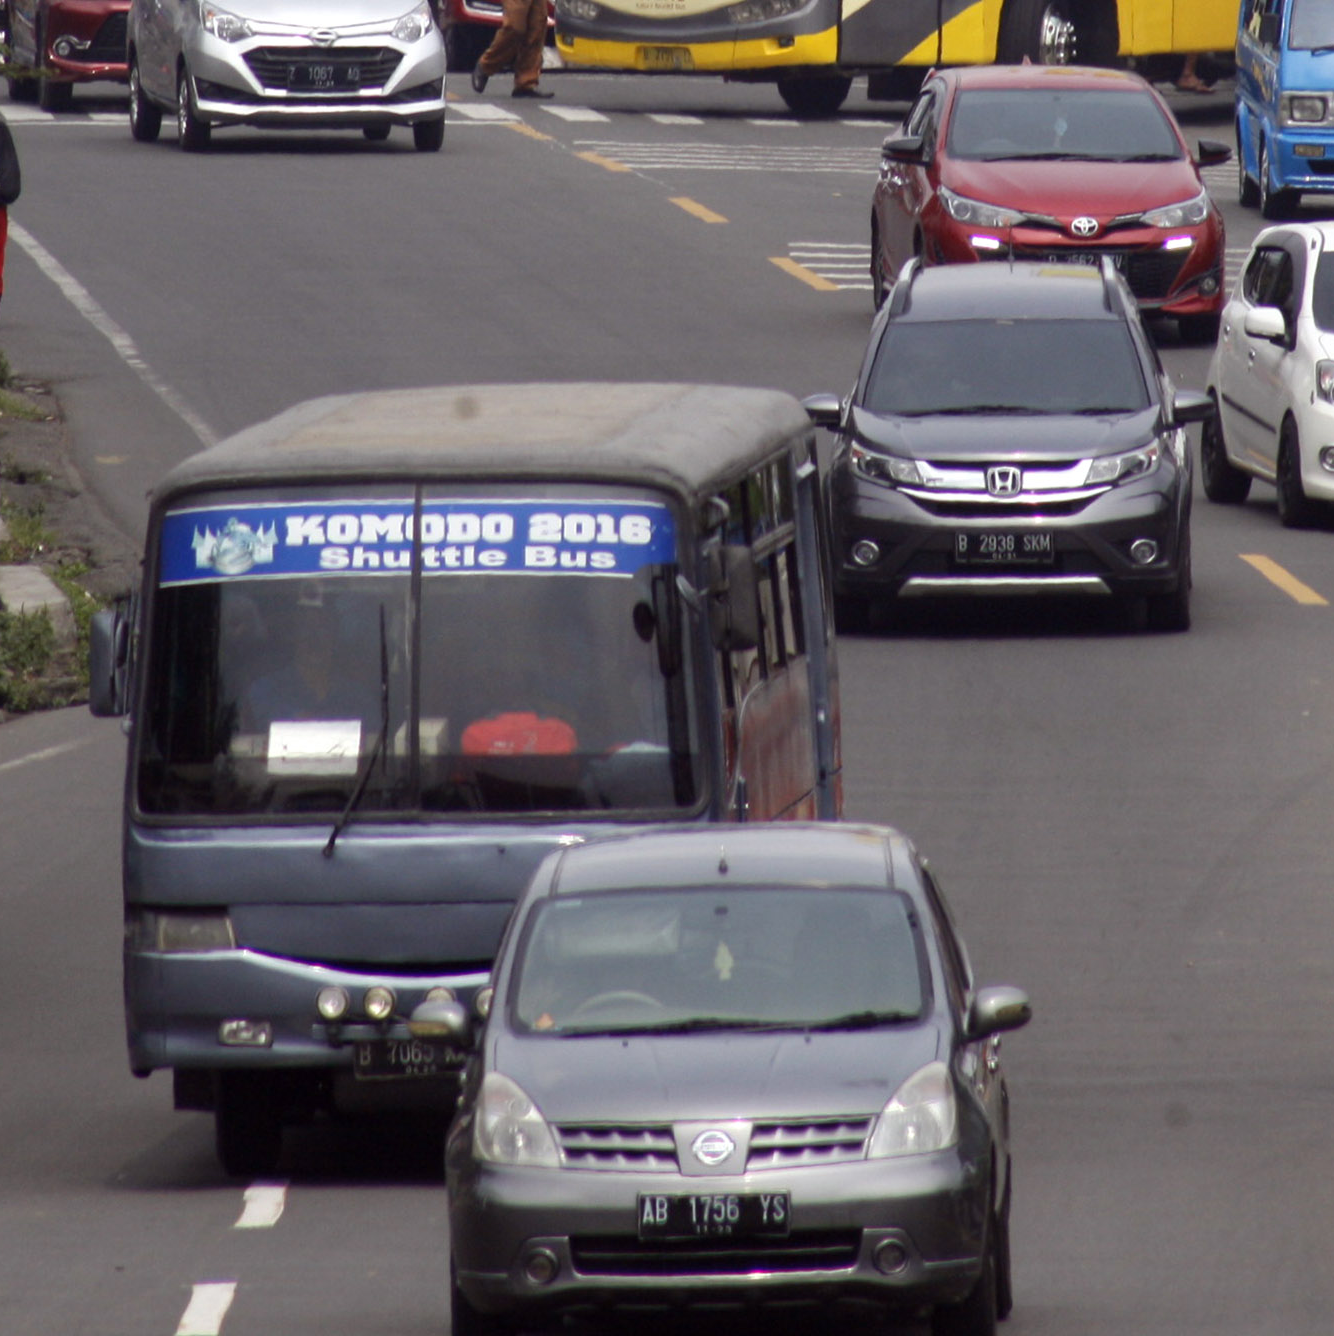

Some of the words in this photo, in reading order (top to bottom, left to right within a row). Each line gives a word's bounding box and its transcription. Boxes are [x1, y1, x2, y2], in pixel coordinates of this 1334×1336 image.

[285, 513, 514, 545] KOMODO
[958, 533, 968, 553] B
[1023, 533, 1051, 552] SKM
[319, 545, 507, 569] Shuttle
[523, 545, 617, 569] Bus
[642, 1195, 668, 1225] AB
[689, 1195, 740, 1224] 1756
[759, 1194, 785, 1224] YS
